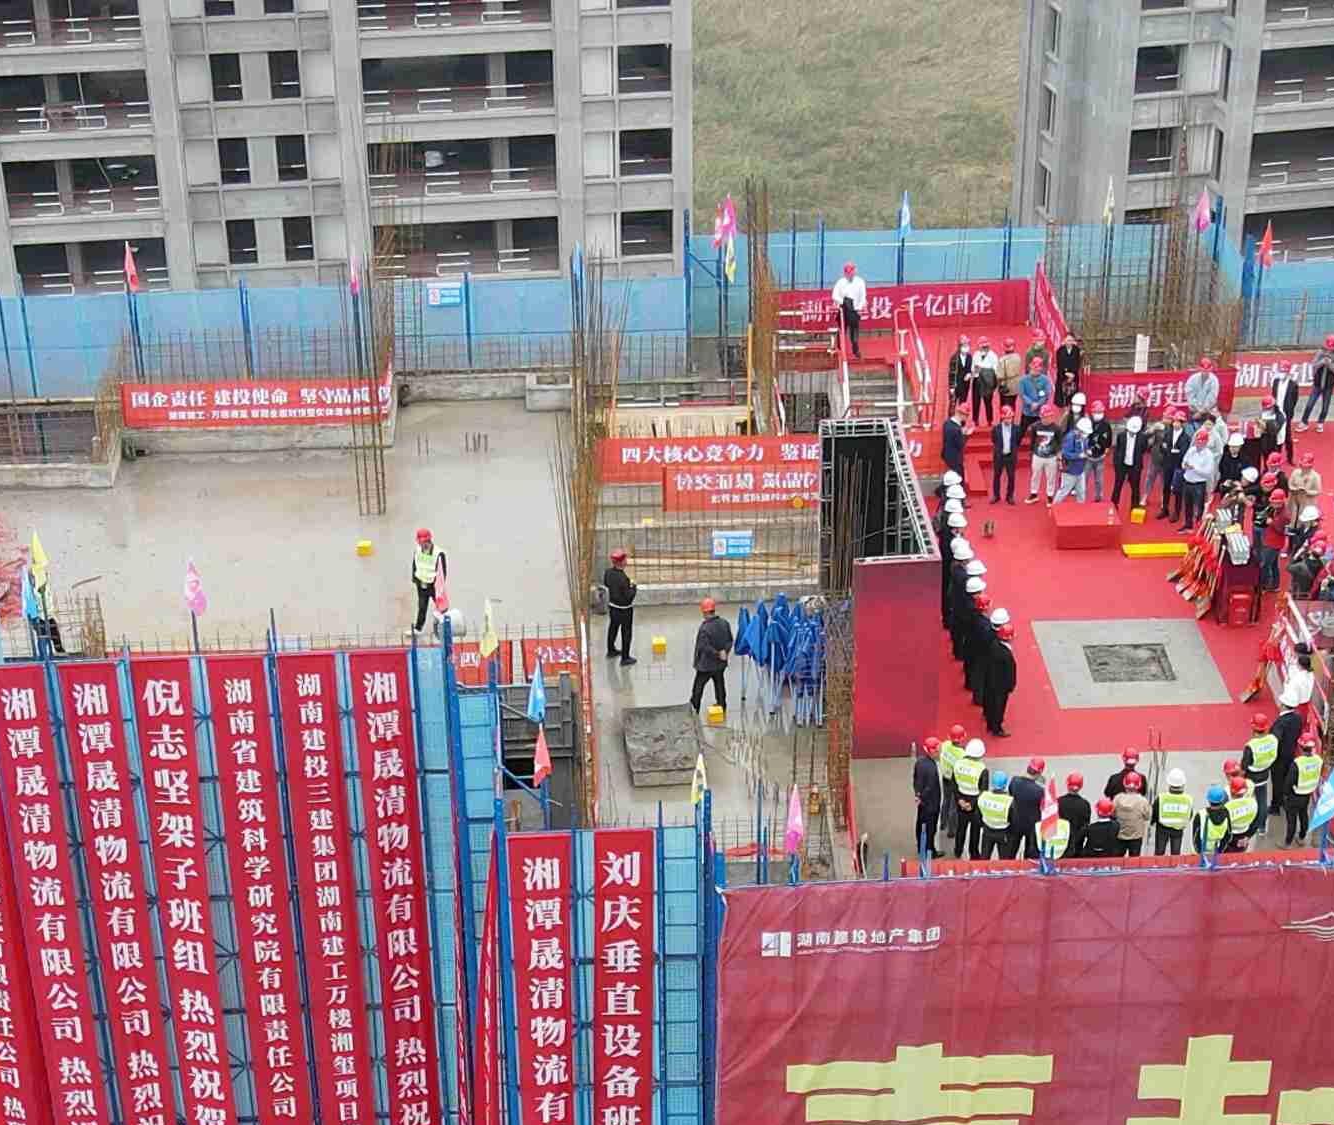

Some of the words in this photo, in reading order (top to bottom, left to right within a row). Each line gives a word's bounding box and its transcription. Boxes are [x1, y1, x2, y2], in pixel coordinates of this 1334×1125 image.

[131, 390, 206, 409] 国企责任
[214, 387, 288, 406] 建投使命
[901, 292, 993, 317] 千亿国企
[621, 444, 764, 464] 四大核心竞争力
[0, 688, 82, 1044] 湘潭晟清物流有限公司
[73, 682, 151, 1036] 湘潭晟清物流有限公司
[142, 679, 209, 974] 倪志坚架子班组
[224, 678, 297, 1119] 湖南省建筑科学研究院有限责任公司
[363, 671, 420, 1023] 湘潭晟清物流有限公司
[797, 926, 941, 947] 湖南建投地产集团
